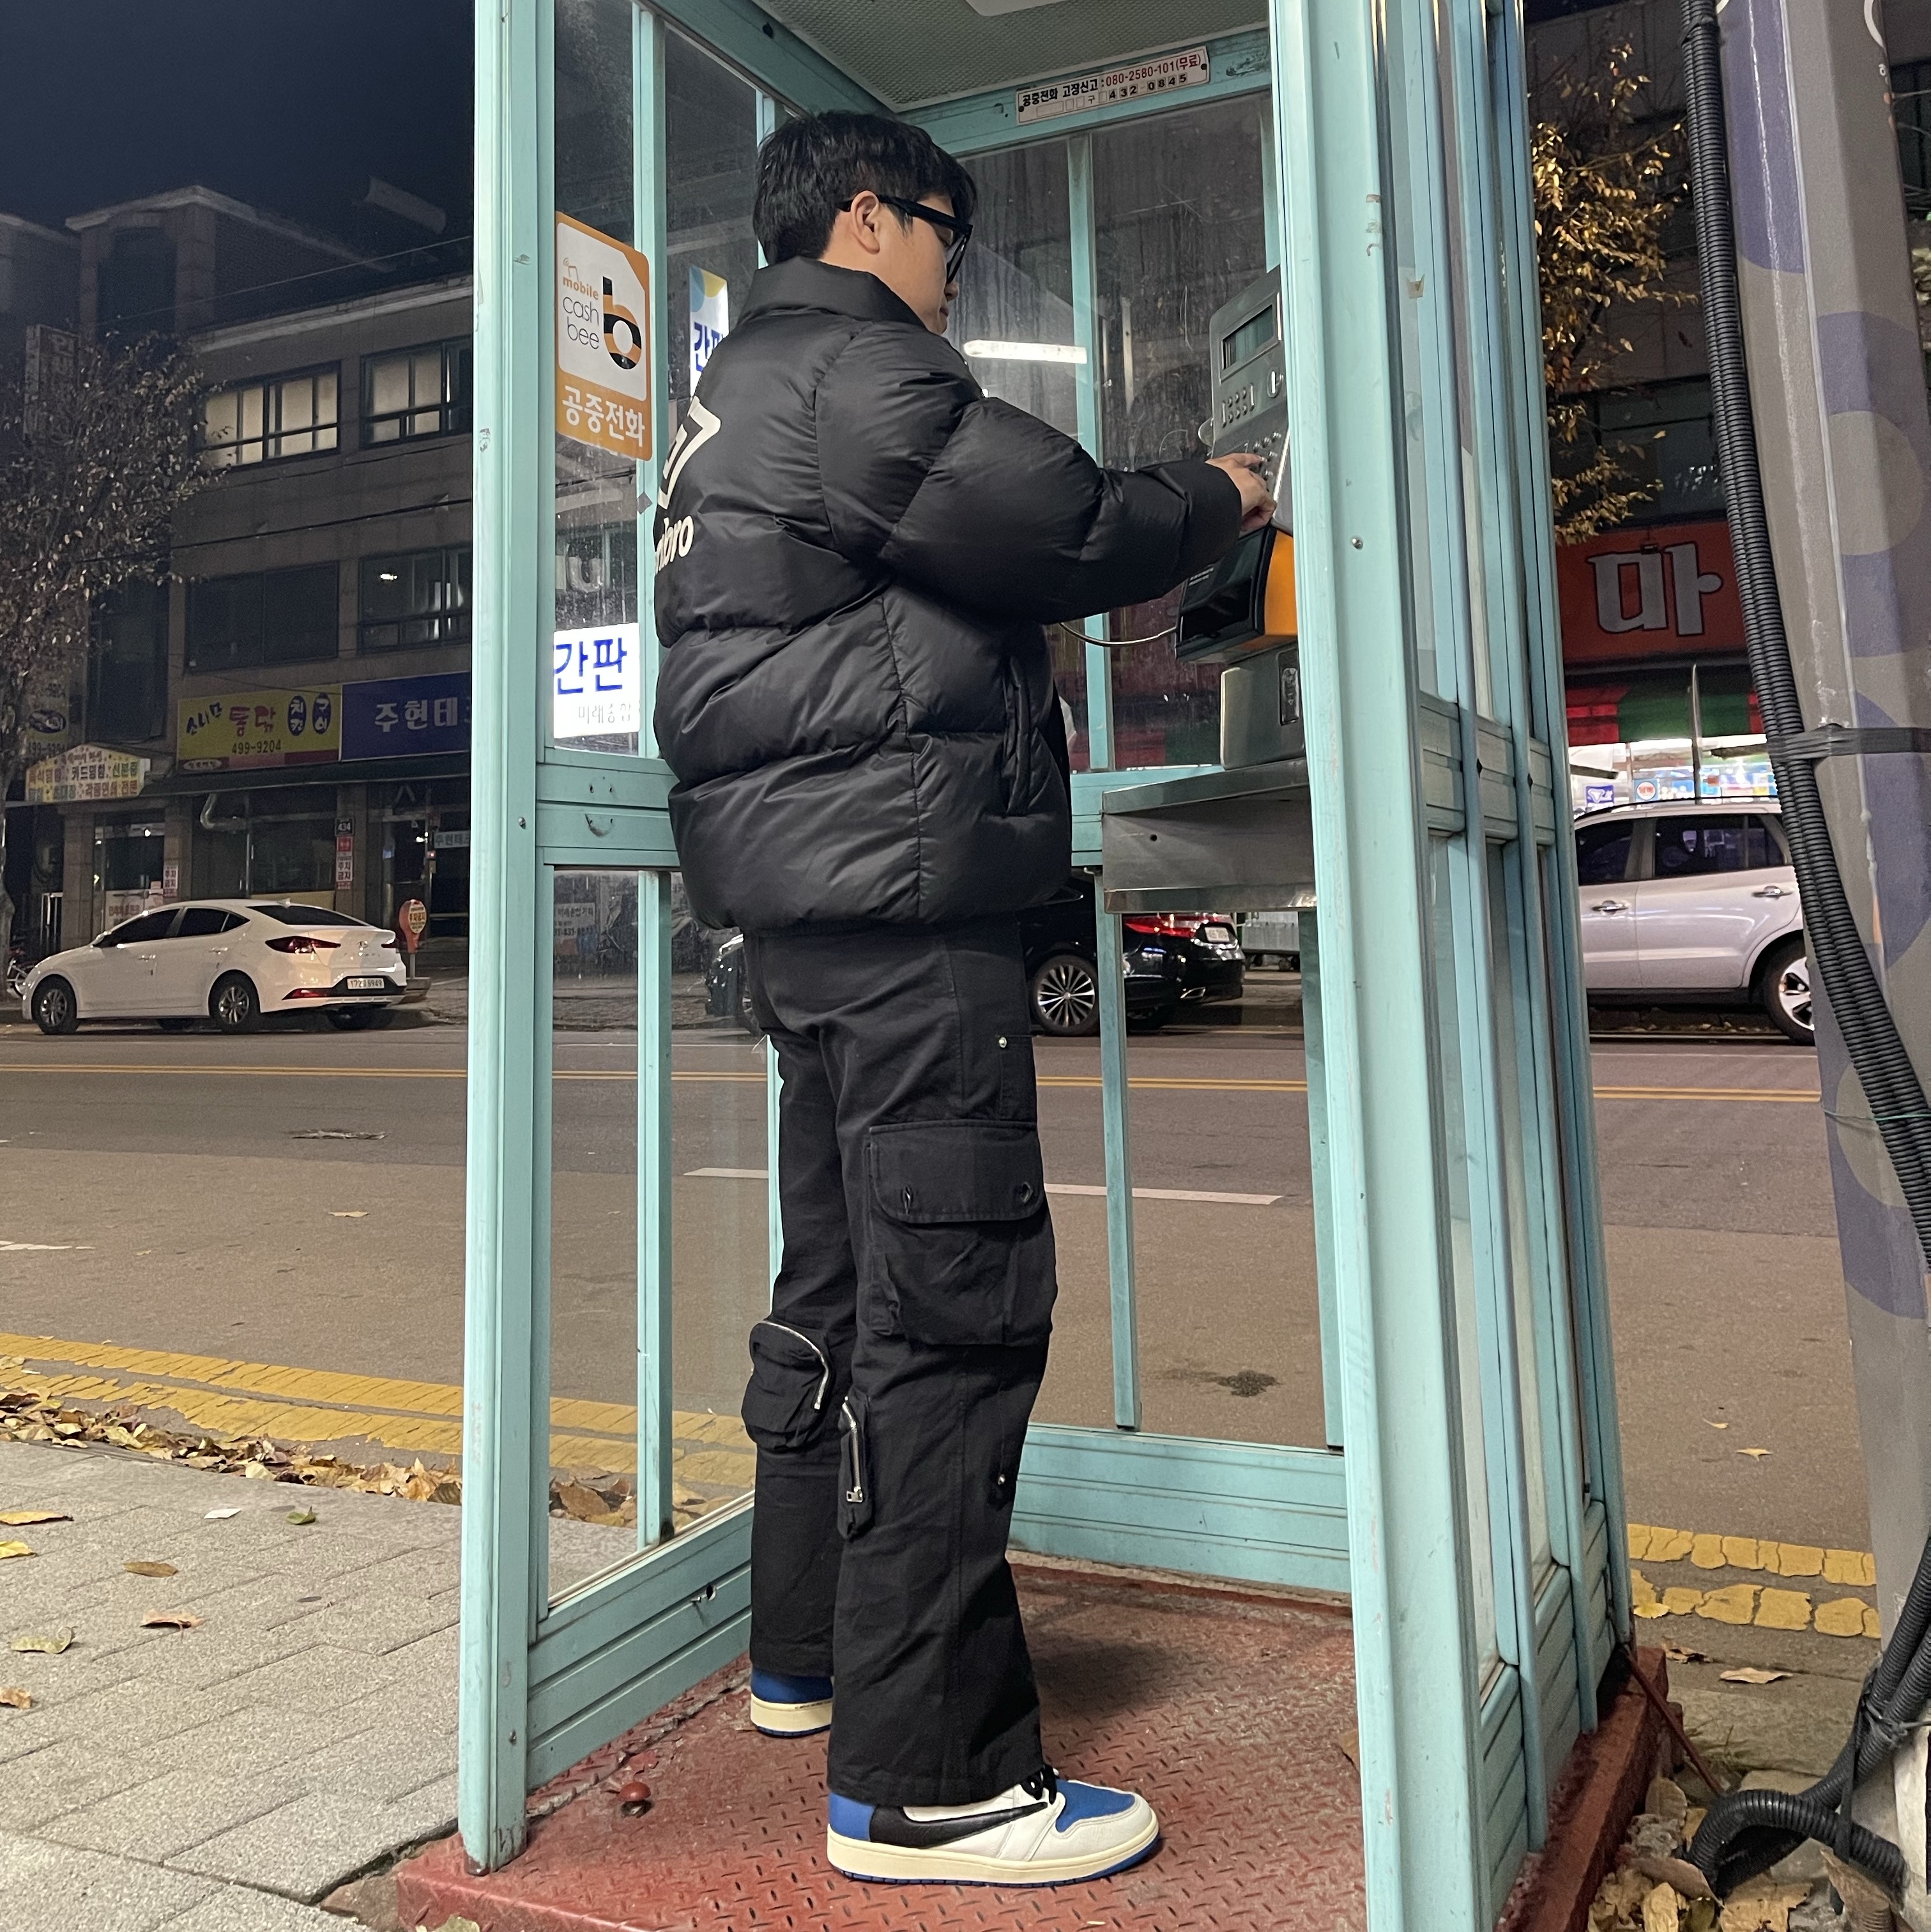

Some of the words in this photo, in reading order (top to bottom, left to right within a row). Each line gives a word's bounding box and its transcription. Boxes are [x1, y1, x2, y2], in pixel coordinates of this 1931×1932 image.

[1023, 87, 1058, 107] 공중전화
[1147, 73, 1187, 91] 0845
[563, 276, 599, 300] mobile
[563, 296, 599, 326] cash
[567, 316, 599, 349] bee
[694, 321, 723, 372] 간
[562, 385, 645, 447] 공중전화
[553, 637, 627, 695] 간판
[229, 705, 276, 737] 통닭
[232, 739, 282, 755] 499-9204
[338, 822, 351, 831] 434
